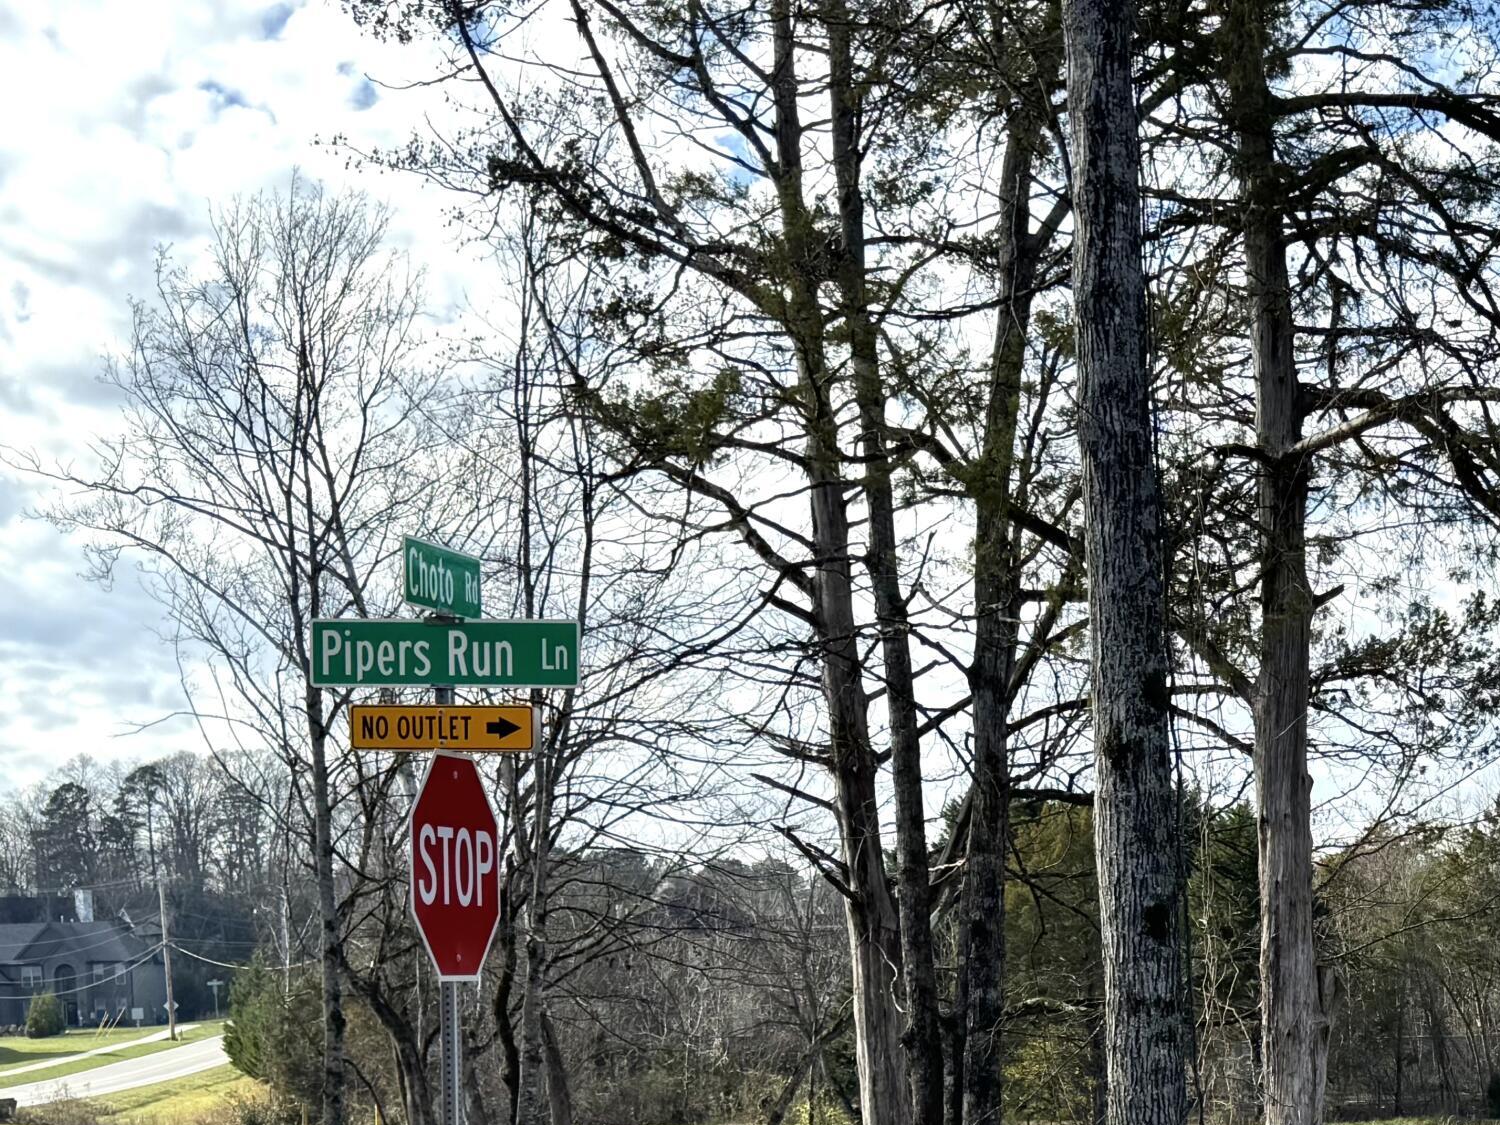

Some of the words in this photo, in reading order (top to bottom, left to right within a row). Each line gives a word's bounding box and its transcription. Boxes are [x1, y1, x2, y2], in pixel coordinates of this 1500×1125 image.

[409, 546, 454, 605] Choto
[464, 571, 479, 605] Rd
[321, 630, 432, 682] Pipers
[448, 630, 513, 677] Run
[541, 638, 569, 670] Ln
[361, 715, 389, 741] NO
[397, 715, 472, 741] OUTLET
[418, 822, 494, 907] STOP
